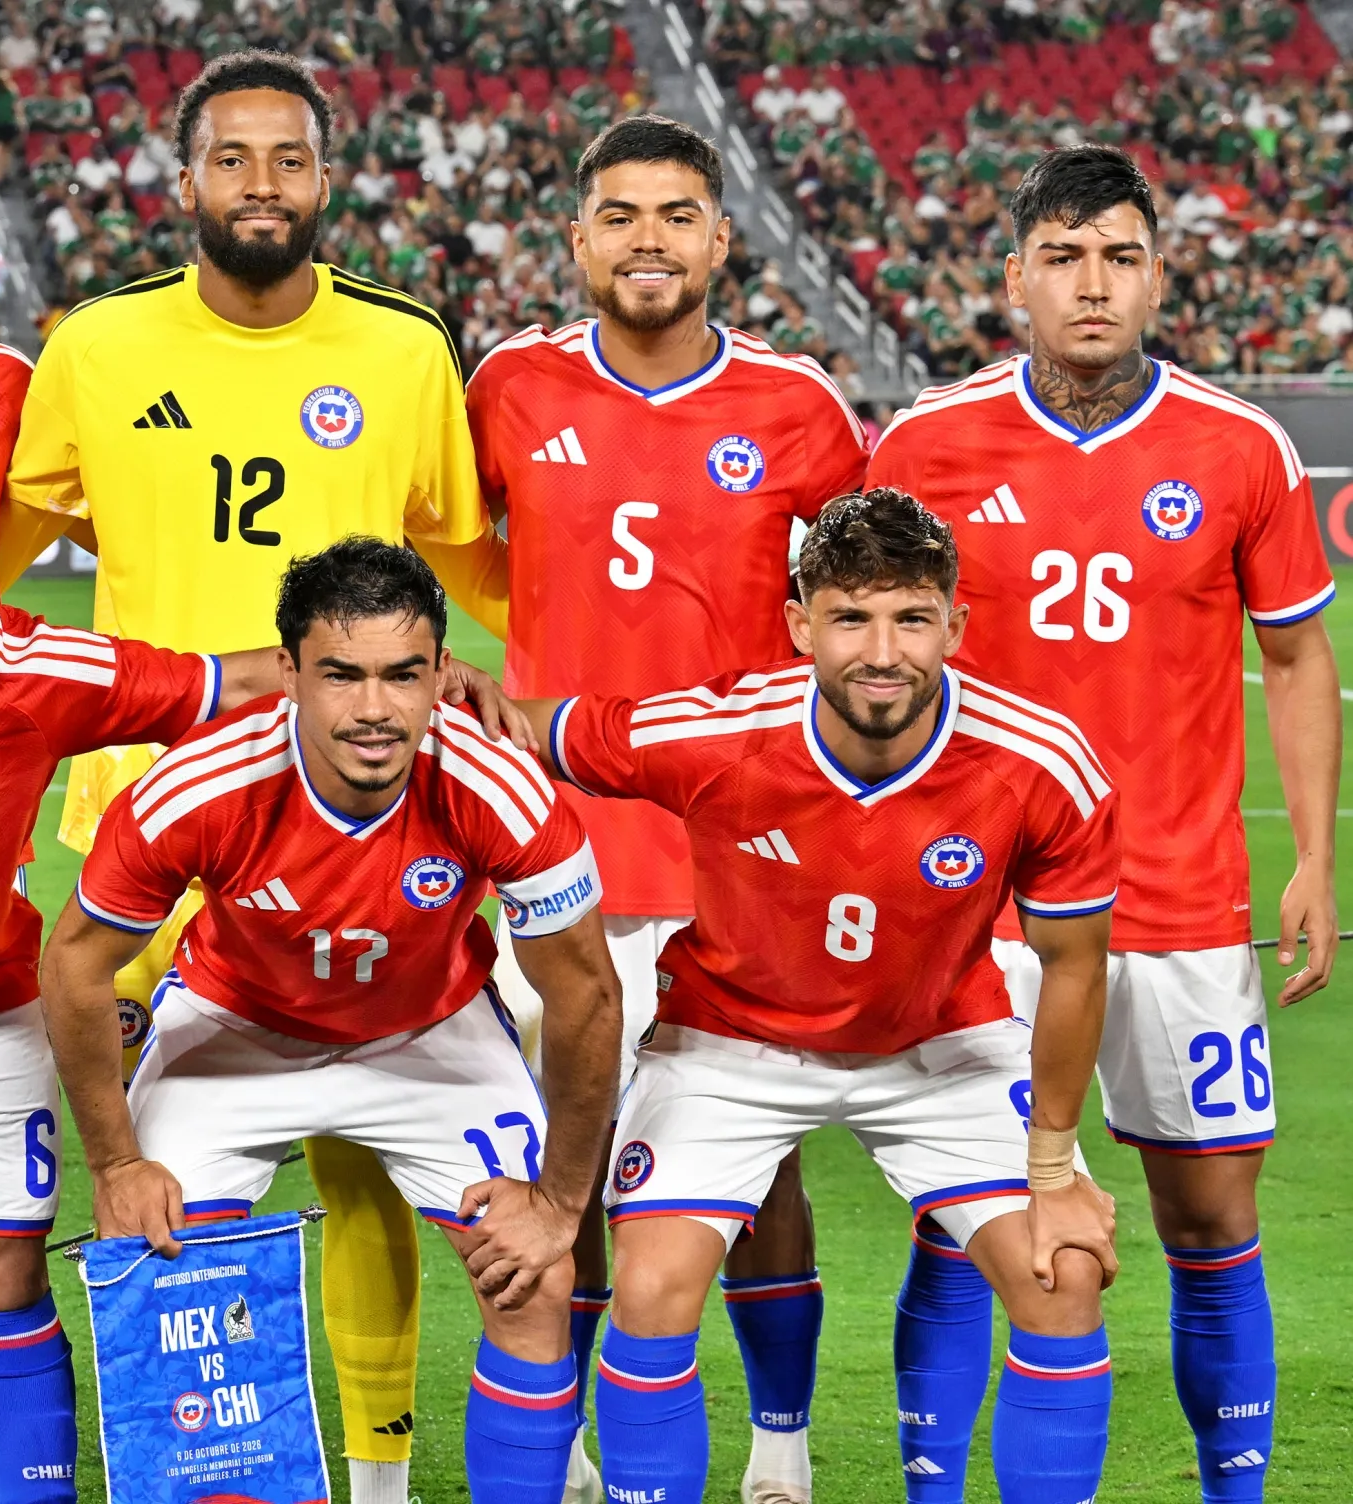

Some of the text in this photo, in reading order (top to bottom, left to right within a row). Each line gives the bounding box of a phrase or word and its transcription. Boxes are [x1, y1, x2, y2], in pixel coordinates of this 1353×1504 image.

[303, 387, 361, 422] FEDERACION DE FUTBOL
[315, 436, 346, 447] DE CHILE
[708, 437, 763, 469] FEDERACION DE FUTBOL
[211, 454, 285, 546] 12
[719, 480, 749, 491] DE CHILE
[1143, 482, 1173, 510] FEDERACION
[1187, 489, 1201, 512] FUTBOL
[608, 502, 659, 590] 5
[1156, 529, 1187, 539] DE CHILE
[1030, 550, 1133, 642] 26
[922, 837, 954, 864] FEDERACION
[968, 843, 983, 865] FUTBOL
[403, 857, 431, 886] FEDERACION
[447, 862, 464, 879] FUTBOL
[935, 879, 968, 887] DE CHILE
[434, 897, 452, 907] CHILE
[530, 873, 593, 917] CAPITÁN
[825, 894, 876, 961] 8
[308, 929, 388, 982] 17
[1188, 1024, 1271, 1118] 26
[25, 1108, 56, 1198] 6
[464, 1111, 542, 1182] 17
[627, 1181, 639, 1189] CHILE
[154, 1264, 247, 1289] AMISTOSO INTERNACIONAL
[159, 1306, 219, 1354] MEX
[199, 1353, 224, 1382] VS
[212, 1382, 261, 1428] CHI
[761, 1411, 804, 1425] CHILE
[1217, 1400, 1271, 1418] CHILE
[166, 1453, 274, 1477] LOS ANGELES MEMORIAL COLISEUM
[184, 1450, 194, 1460] DE
[195, 1444, 229, 1459] OCTUBRE
[230, 1442, 240, 1454] DE
[22, 1464, 73, 1480] CHILE
[189, 1476, 201, 1484] LOS
[608, 1484, 666, 1504] CHILE
